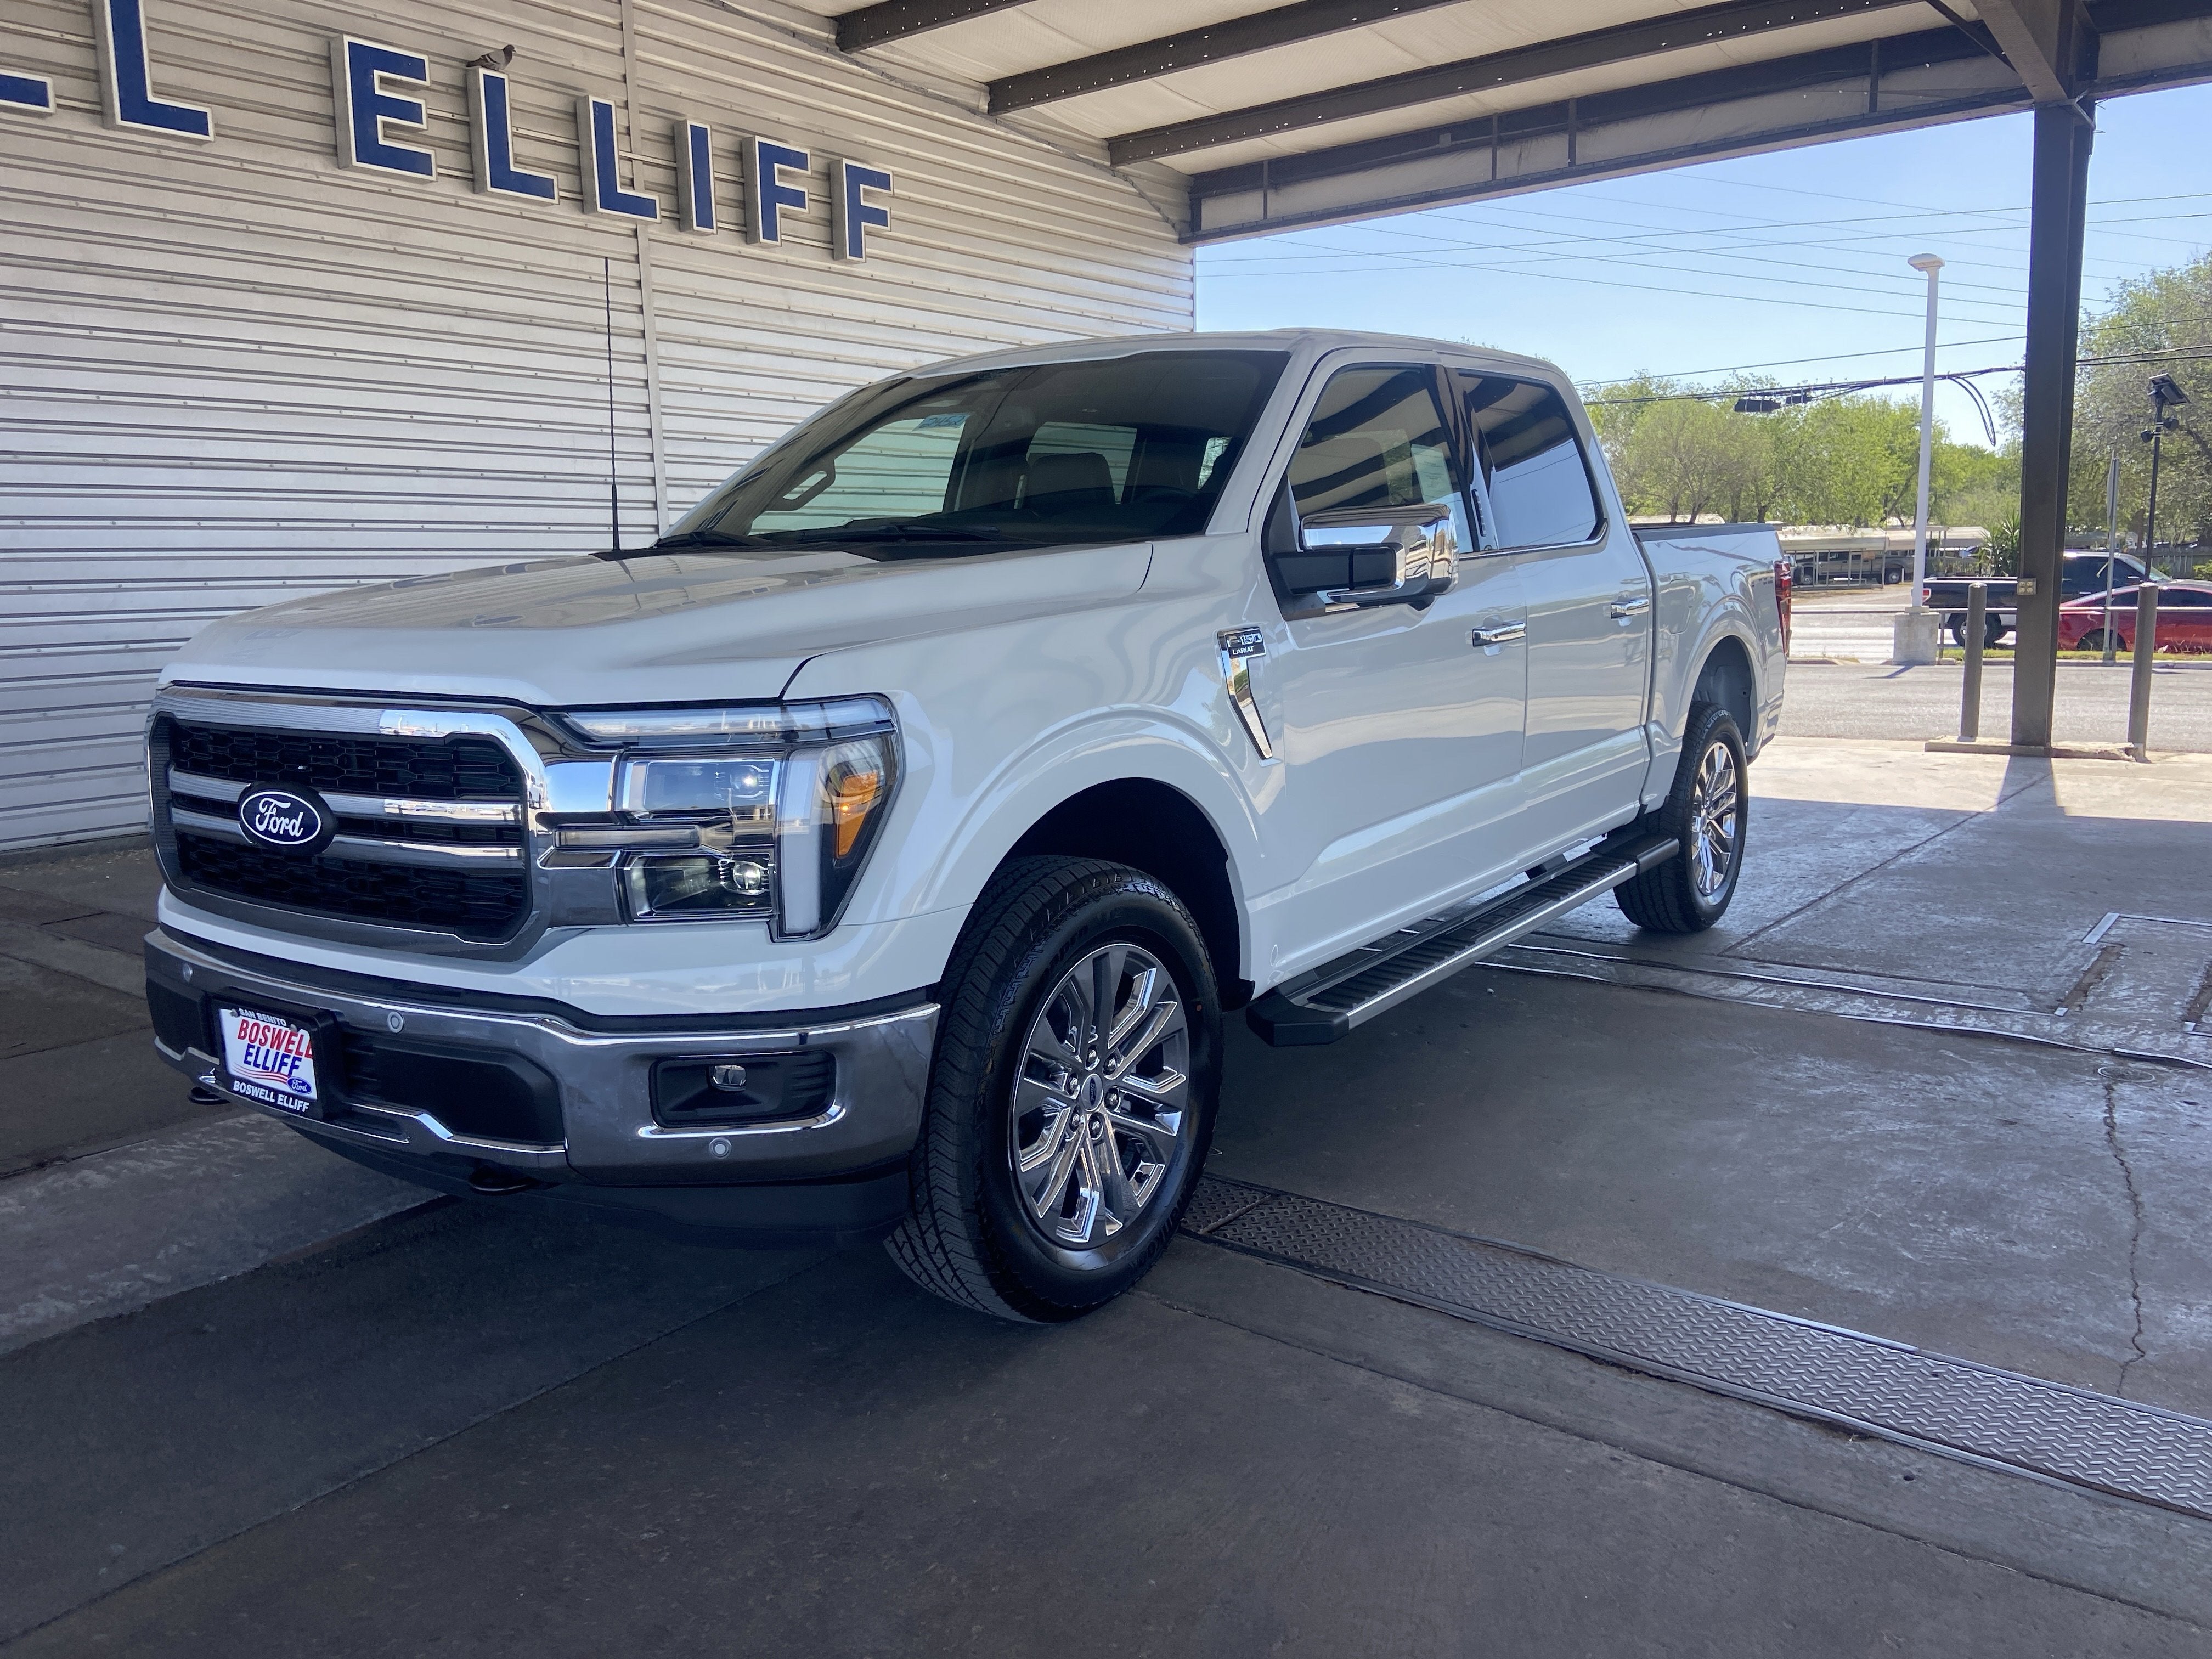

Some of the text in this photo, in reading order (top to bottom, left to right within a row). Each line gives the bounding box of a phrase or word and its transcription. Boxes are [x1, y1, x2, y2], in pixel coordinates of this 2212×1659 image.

[0, 0, 895, 263] L ELLIFF
[1233, 646, 1254, 655] LARIAT
[255, 797, 304, 838] Ford
[238, 1008, 287, 1026] SAN BENITO
[238, 1018, 313, 1059] BOSWELL
[244, 1043, 302, 1078] ELLIFF
[233, 1080, 309, 1113] BOSWELL ELLIFF
[291, 1079, 308, 1092] Ford
